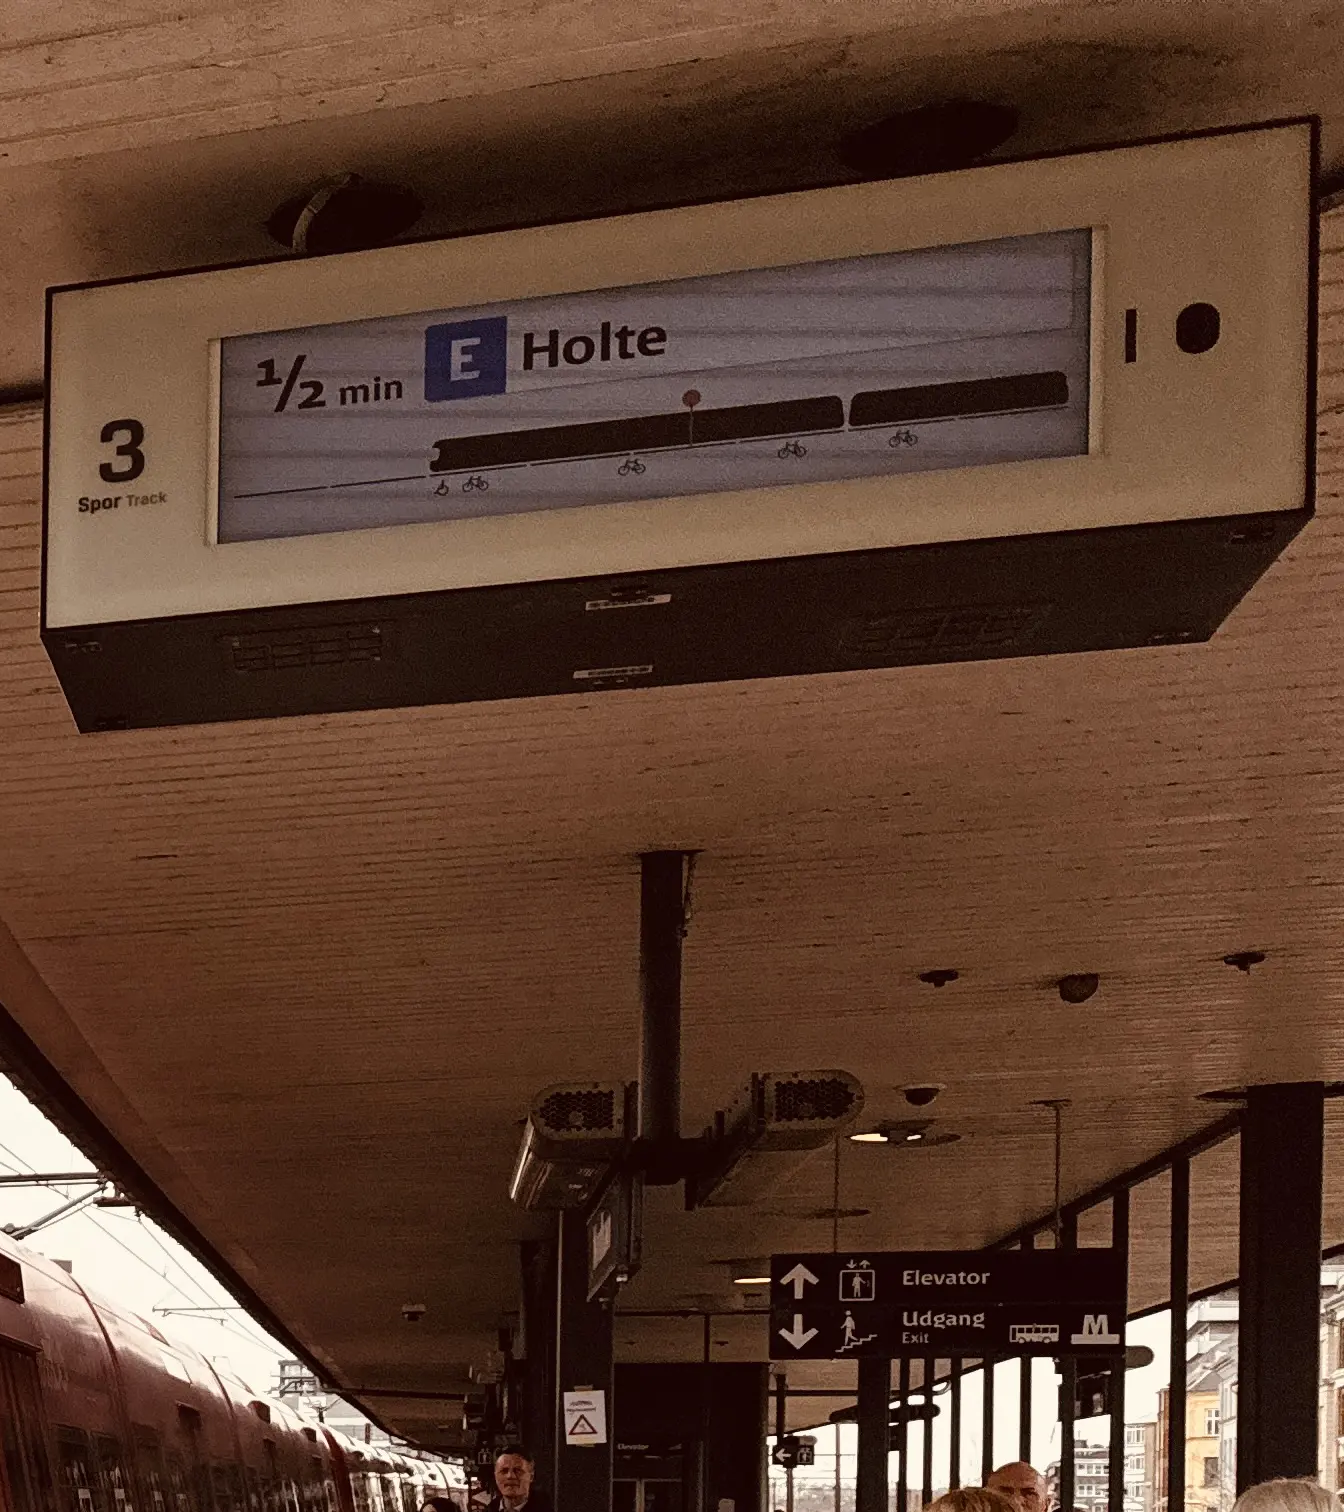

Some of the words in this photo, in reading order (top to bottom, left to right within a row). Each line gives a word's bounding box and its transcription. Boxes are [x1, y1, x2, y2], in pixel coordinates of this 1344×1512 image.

[339, 375, 403, 406] min
[450, 337, 482, 382] E
[523, 320, 668, 372] Holte
[99, 418, 145, 483] 3
[78, 496, 122, 514] Spor
[125, 491, 168, 507] Track
[902, 1269, 991, 1286] Elevator
[902, 1310, 986, 1330] Udgang
[902, 1331, 929, 1344] Exit
